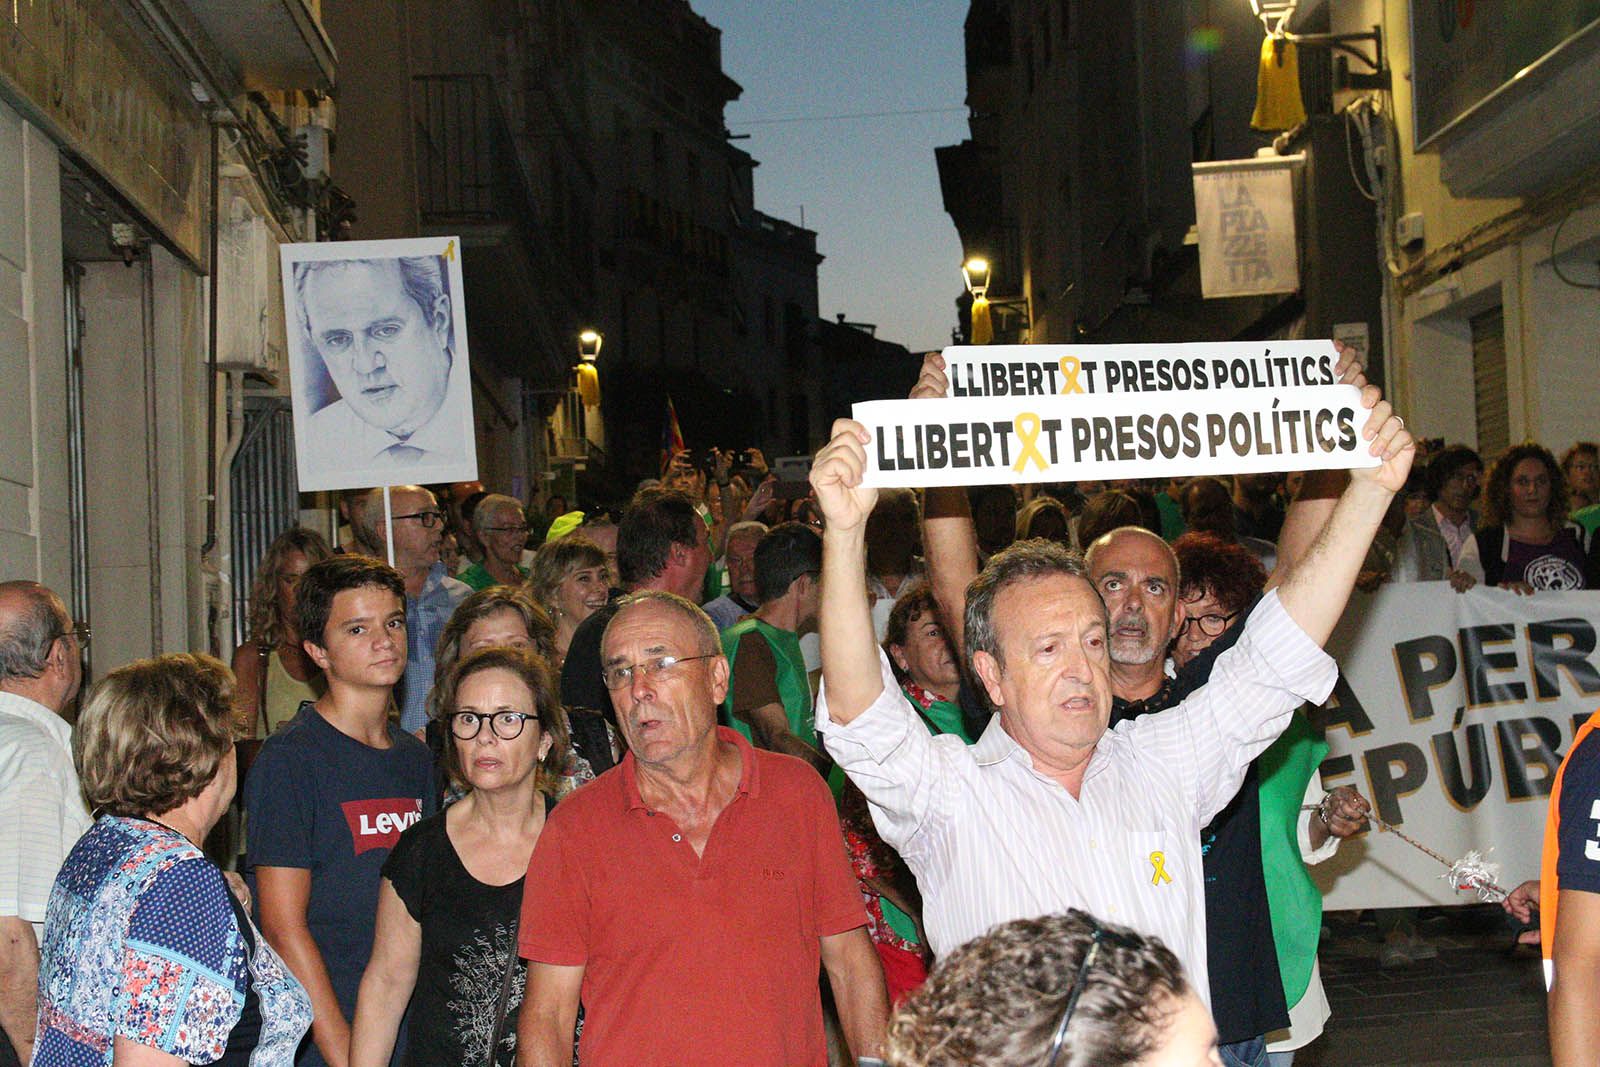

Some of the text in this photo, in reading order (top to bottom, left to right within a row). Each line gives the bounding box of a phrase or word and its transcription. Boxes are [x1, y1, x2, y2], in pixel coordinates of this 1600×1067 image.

[1218, 184, 1255, 209] LA
[1224, 257, 1274, 283] TTA
[1104, 358, 1208, 393] PRESOS
[1212, 348, 1333, 389] POLÍTICS
[1071, 411, 1201, 463] PRESOS
[1206, 397, 1357, 458] POLÍTICS
[1391, 617, 1600, 724] PER
